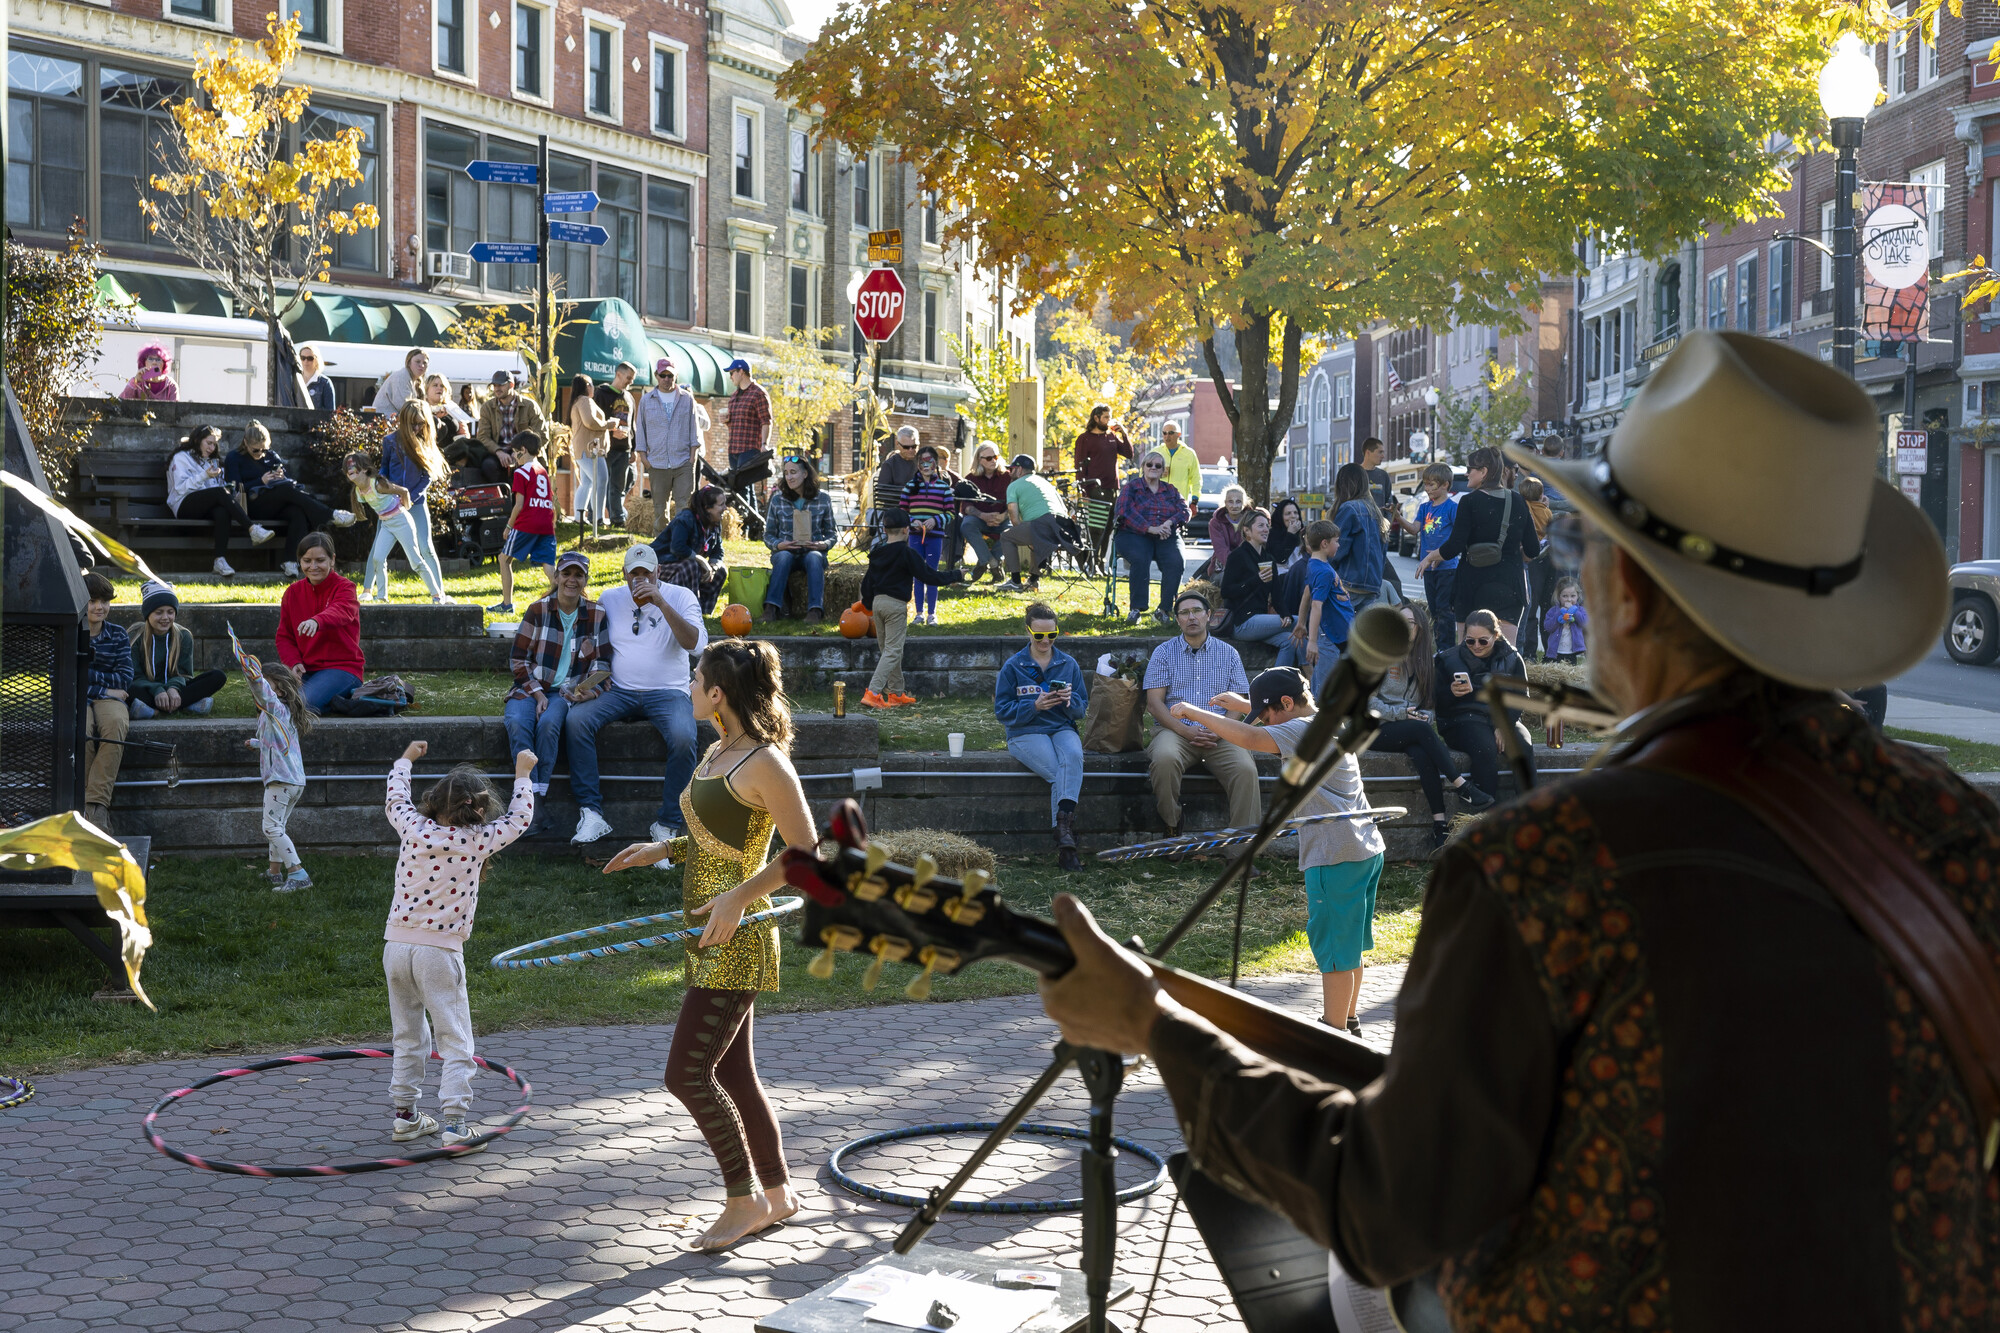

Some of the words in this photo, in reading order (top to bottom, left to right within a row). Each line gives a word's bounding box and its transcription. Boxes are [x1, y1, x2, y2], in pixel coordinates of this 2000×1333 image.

[870, 233, 887, 245] MAIN
[1868, 227, 1924, 260] SARANAC
[869, 248, 900, 261] BROADWAY
[1883, 246, 1911, 265] LAKE
[858, 290, 902, 319] STOP
[612, 346, 623, 360] 86
[583, 361, 616, 374] SURGICAL
[1898, 434, 1925, 447] STOP
[535, 474, 548, 498] 9
[529, 497, 553, 509] LYNCH
